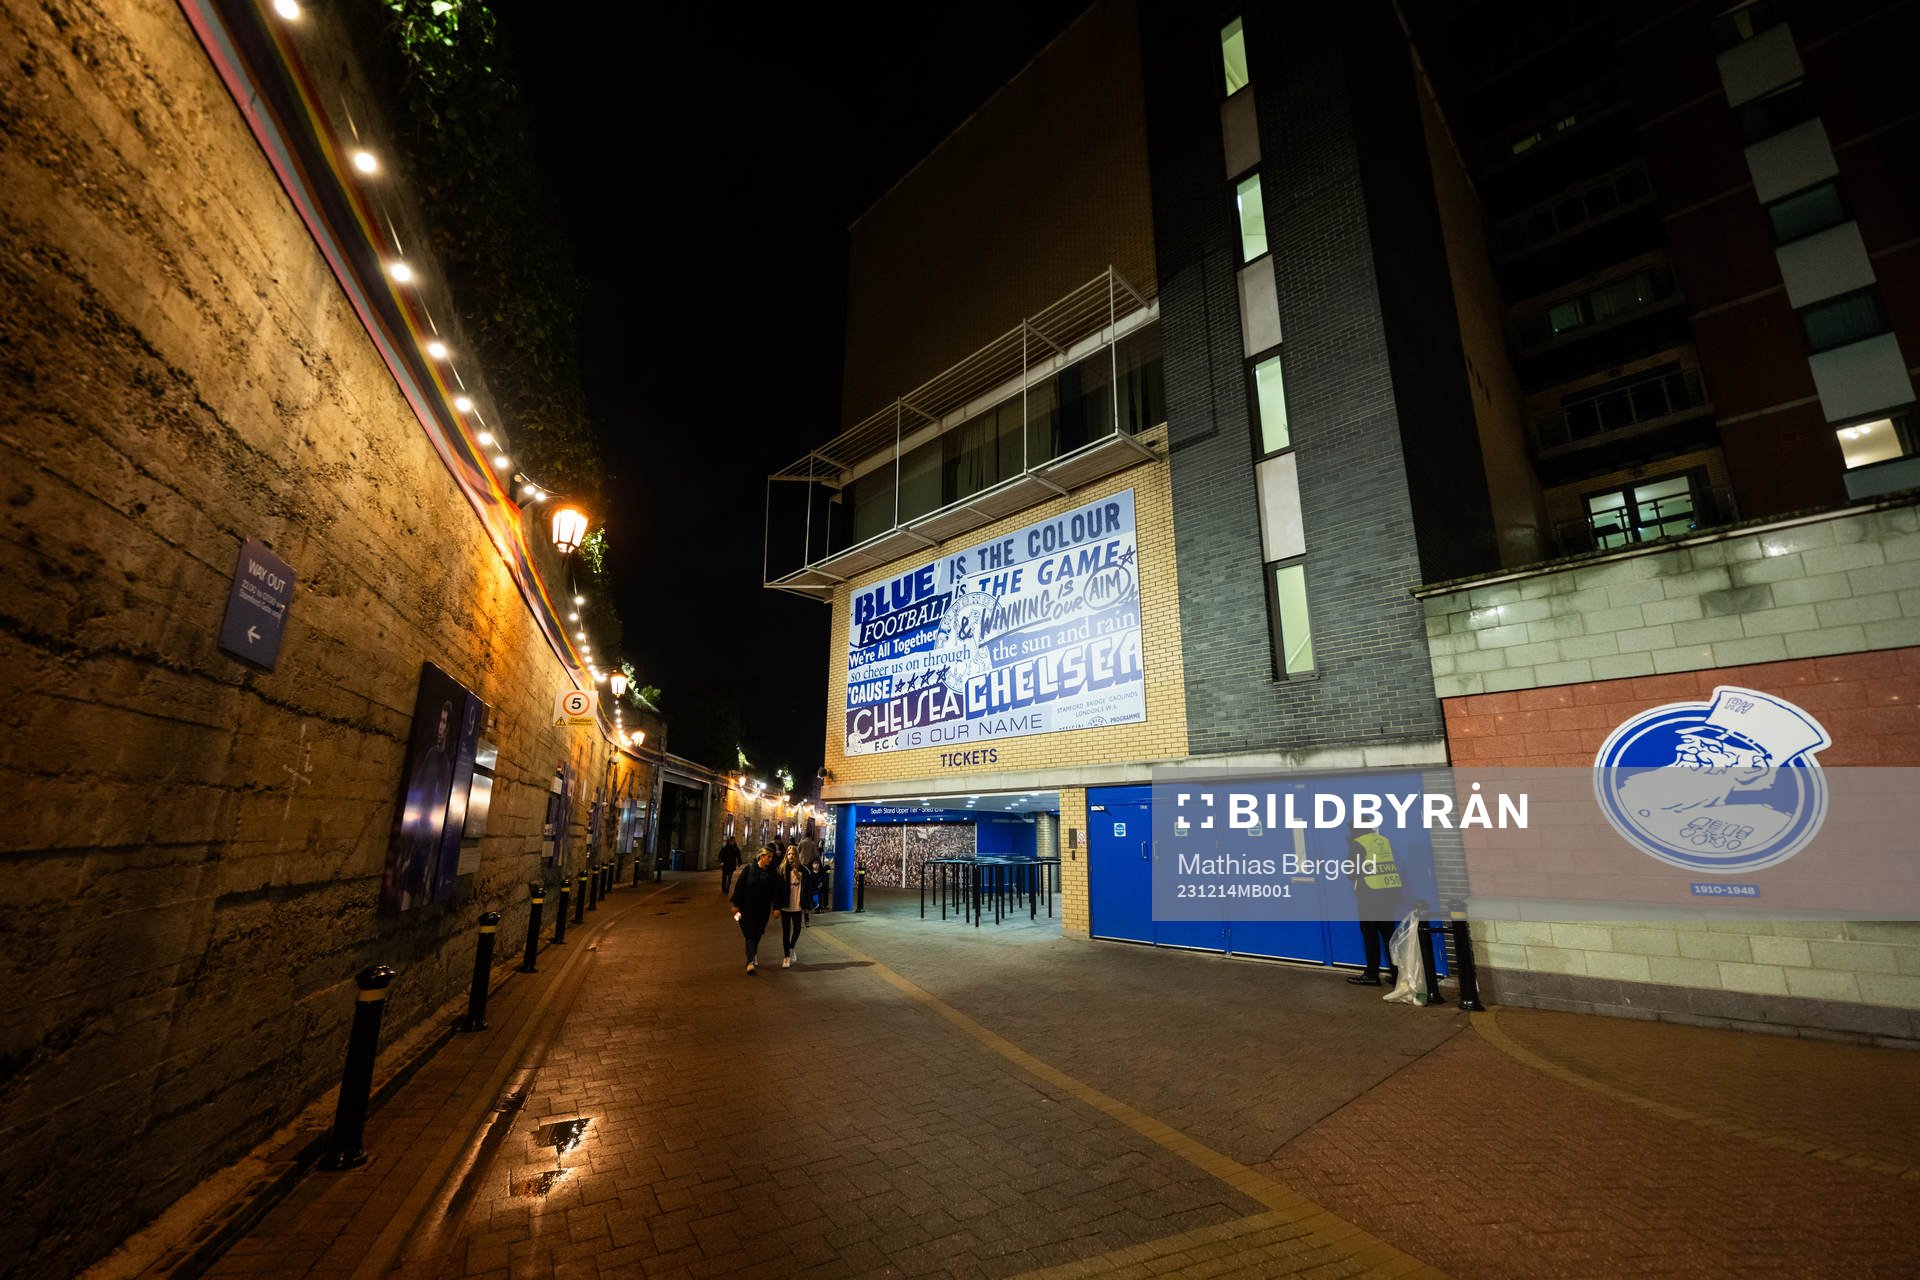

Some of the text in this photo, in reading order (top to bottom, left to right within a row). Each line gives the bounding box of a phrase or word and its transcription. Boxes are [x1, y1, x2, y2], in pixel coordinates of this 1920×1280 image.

[248, 559, 286, 593] WAY OUT
[855, 502, 1121, 626] BLUE IS THE COLOUR
[862, 540, 1121, 644] FOOTBALL is THE GAME
[1058, 580, 1074, 599] IS
[1089, 569, 1124, 600] AIM
[981, 589, 1053, 639] WINNING
[1053, 596, 1084, 620] OUR
[959, 616, 973, 640] &
[849, 629, 938, 667] We're All Together
[851, 610, 1135, 682] so cheer us on through the sun and rain
[848, 679, 890, 705] 'CAUSE
[853, 630, 1143, 739] CHELSEA CHELSEA
[571, 697, 582, 710] 5
[907, 713, 1042, 746] IS OUR NAME
[940, 748, 998, 768] TICKETS
